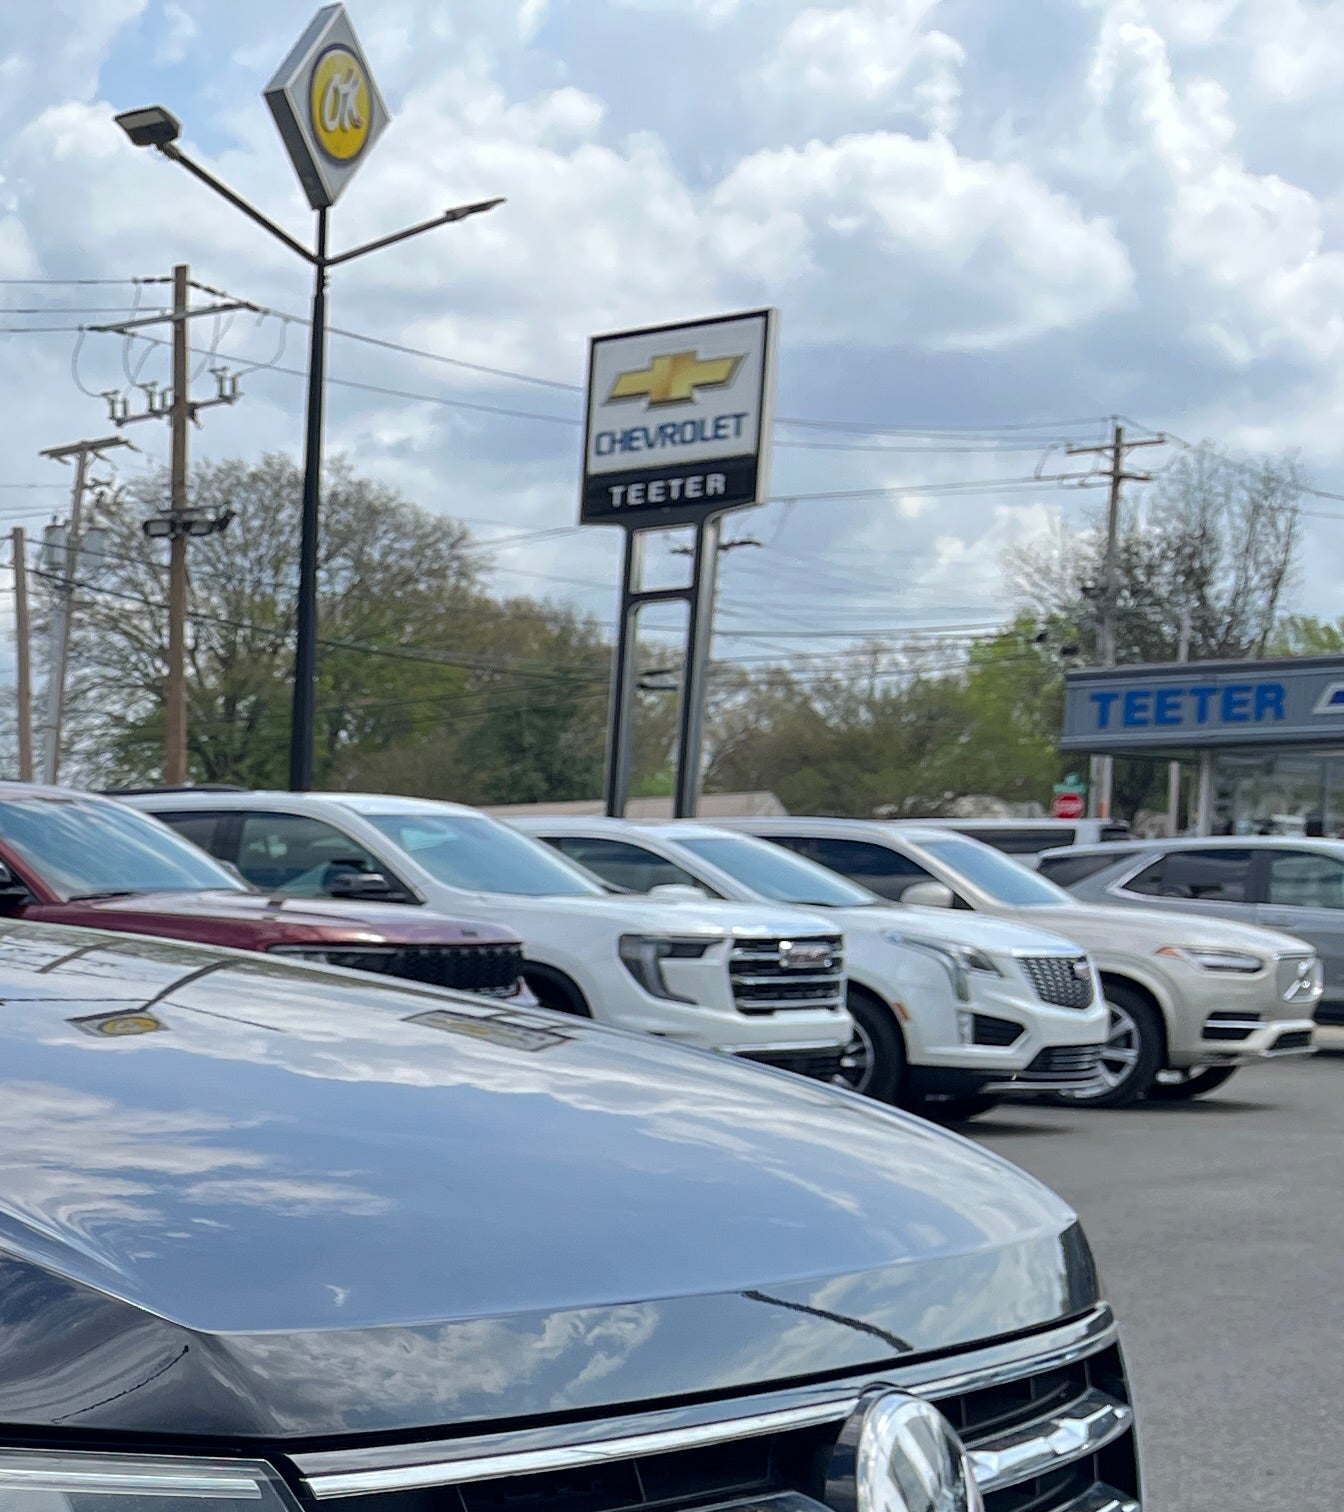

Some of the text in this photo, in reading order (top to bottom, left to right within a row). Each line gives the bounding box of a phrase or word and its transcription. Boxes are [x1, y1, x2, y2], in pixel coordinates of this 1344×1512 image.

[322, 68, 364, 133] OK
[594, 411, 749, 457] CHEVROLET
[607, 472, 727, 508] TEETER
[1090, 682, 1286, 730] TEETER
